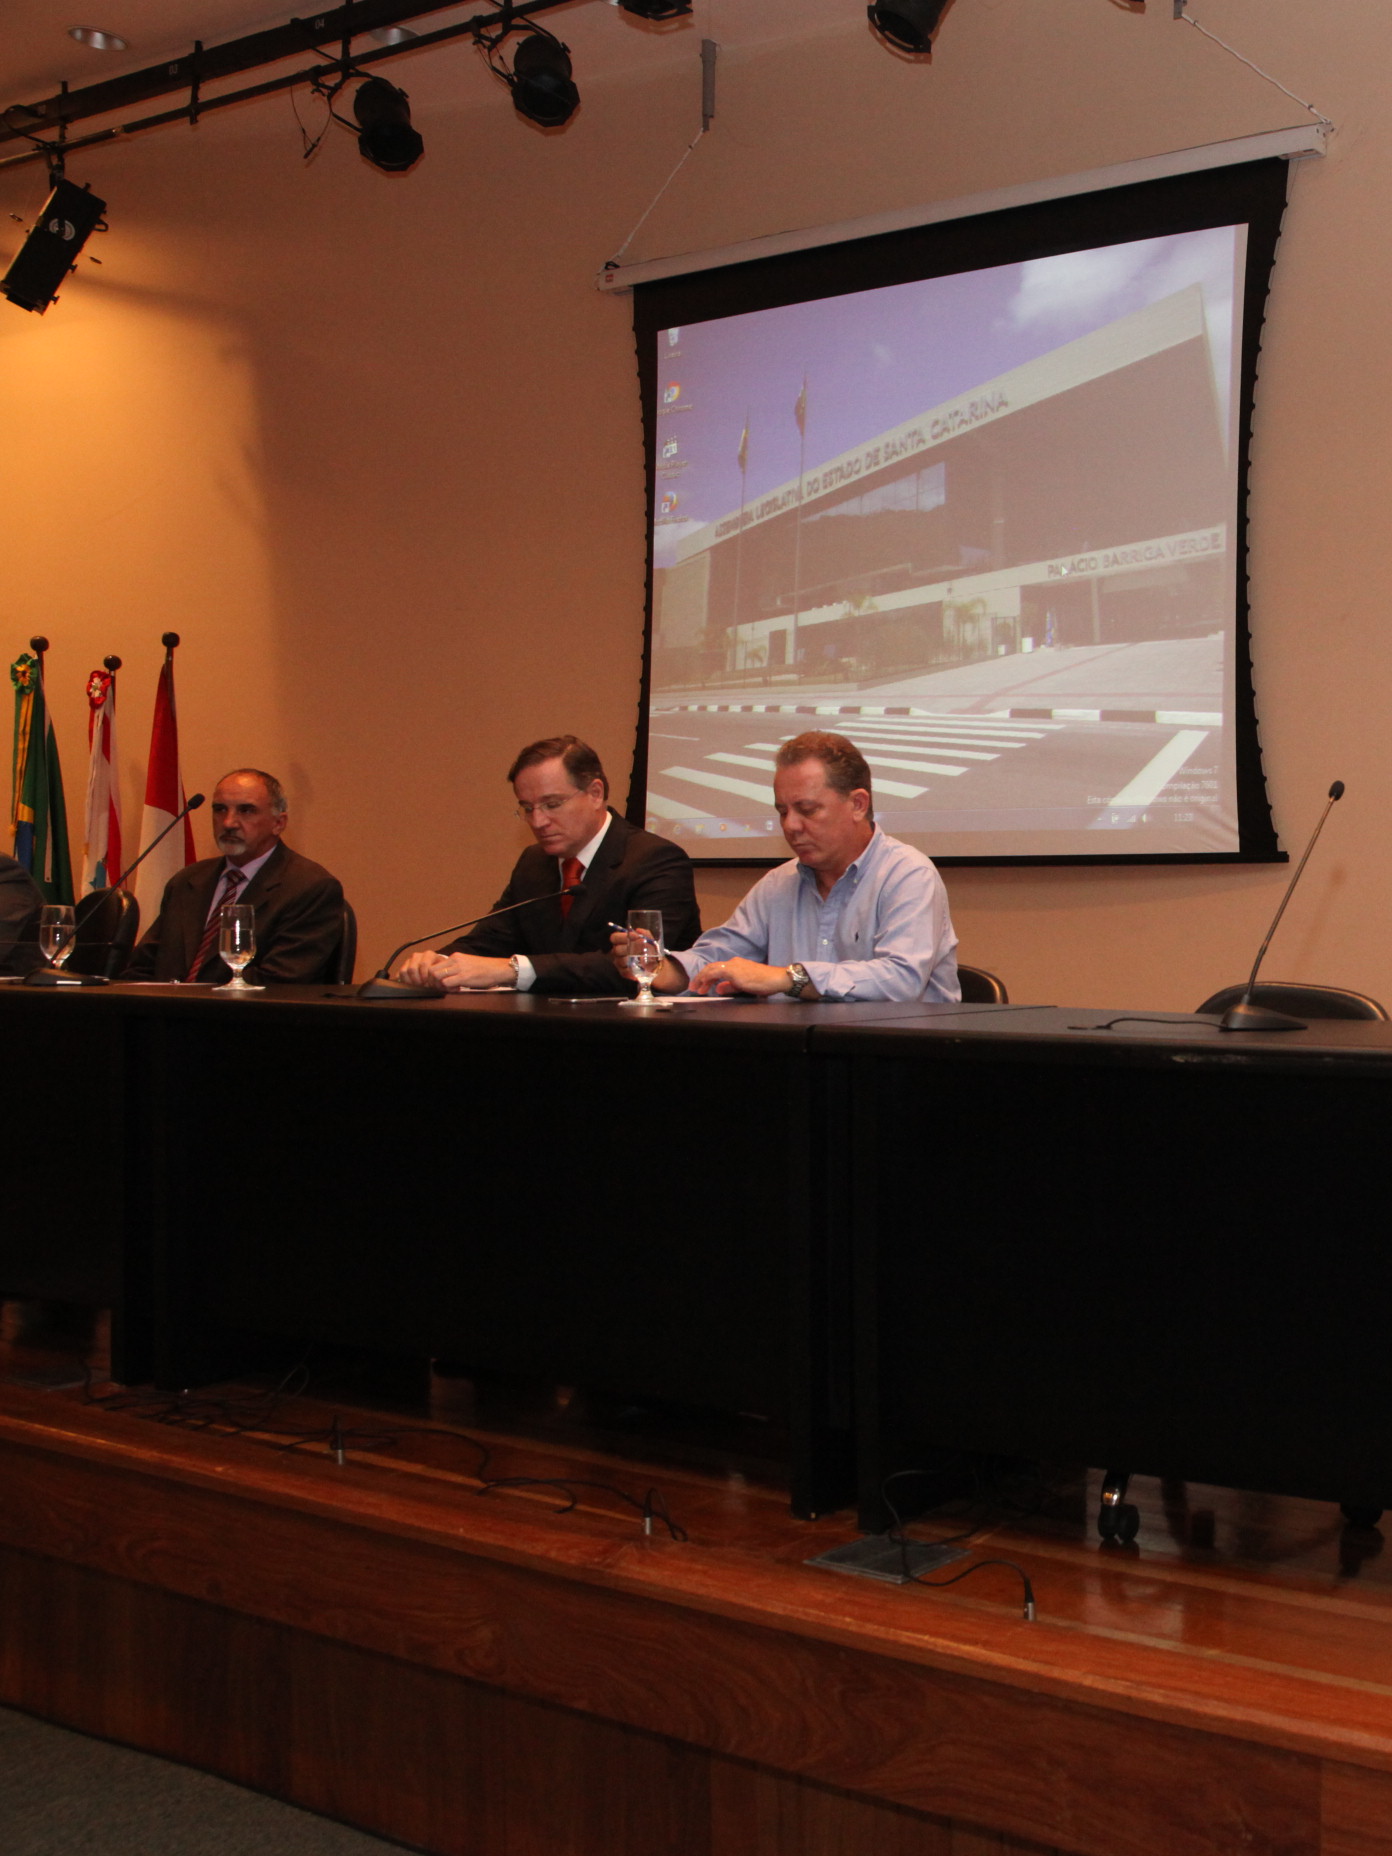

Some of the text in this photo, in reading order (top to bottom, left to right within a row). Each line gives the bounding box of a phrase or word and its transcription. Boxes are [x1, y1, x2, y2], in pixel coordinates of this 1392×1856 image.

[884, 429, 926, 462] SANTA
[930, 390, 1009, 440] CATARINA
[1167, 532, 1222, 556] VERDE
